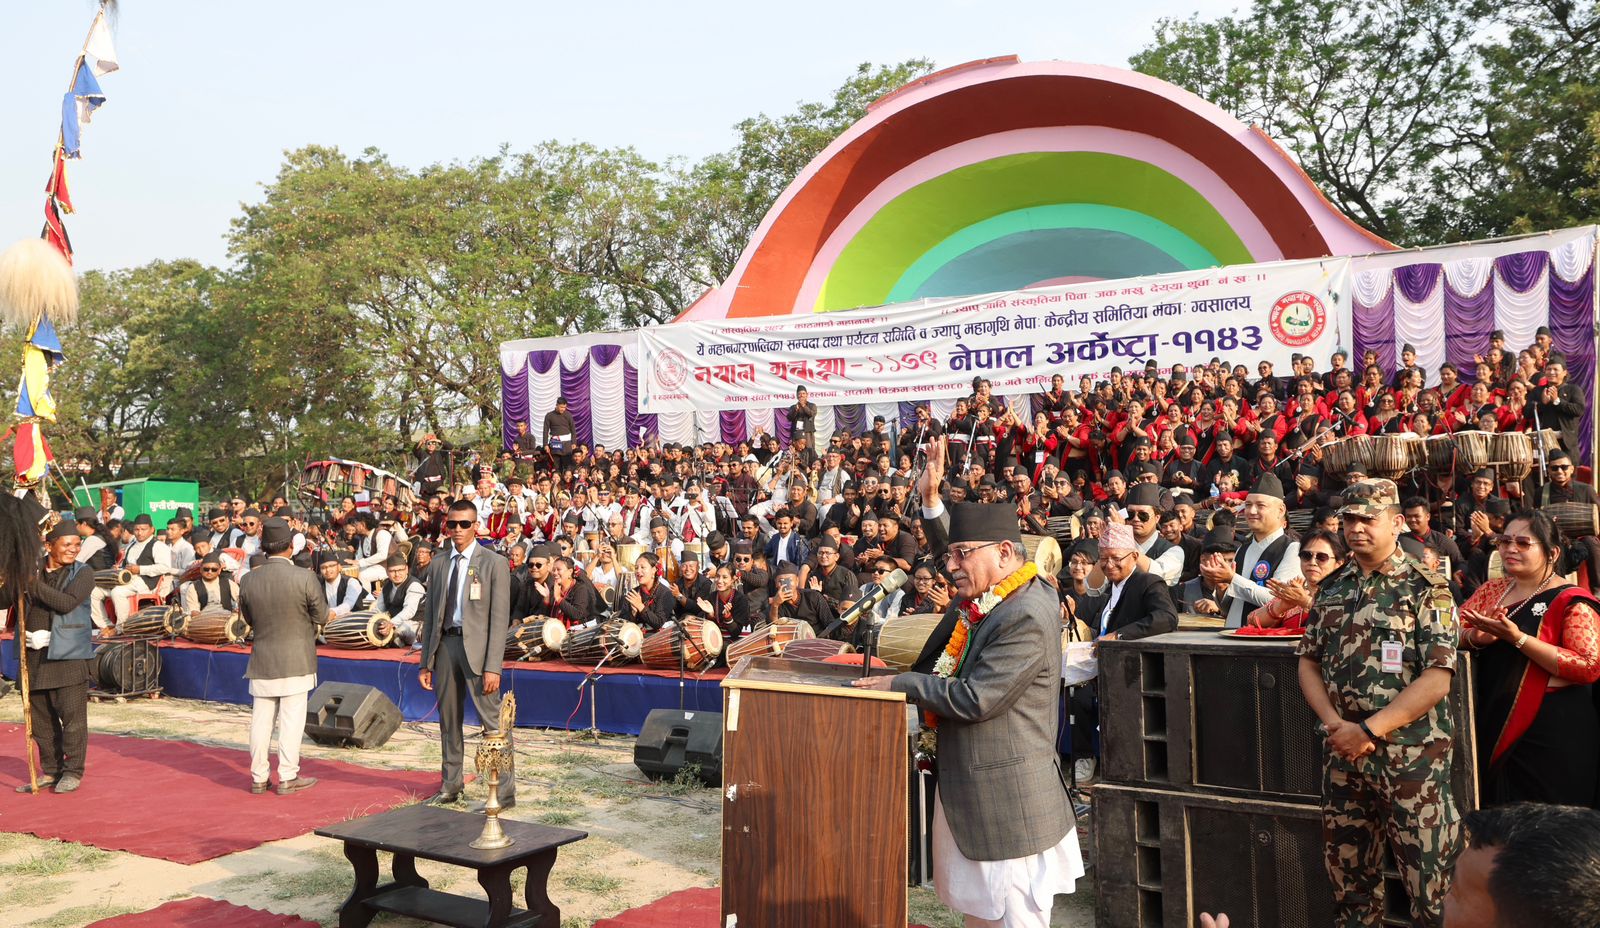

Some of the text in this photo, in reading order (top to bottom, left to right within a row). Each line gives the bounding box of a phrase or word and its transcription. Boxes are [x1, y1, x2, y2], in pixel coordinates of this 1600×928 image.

[787, 337, 820, 350] सम्पदा
[823, 336, 843, 348] तथा
[847, 331, 879, 346] पर्यटन
[883, 325, 917, 343] समिति
[920, 328, 927, 339] व
[931, 324, 962, 339] ज्यापु
[964, 316, 1010, 337] महागुथि
[1045, 310, 1088, 328] केन्द्रीय
[1093, 303, 1148, 323] समितिया
[949, 343, 1035, 371] नेपाल
